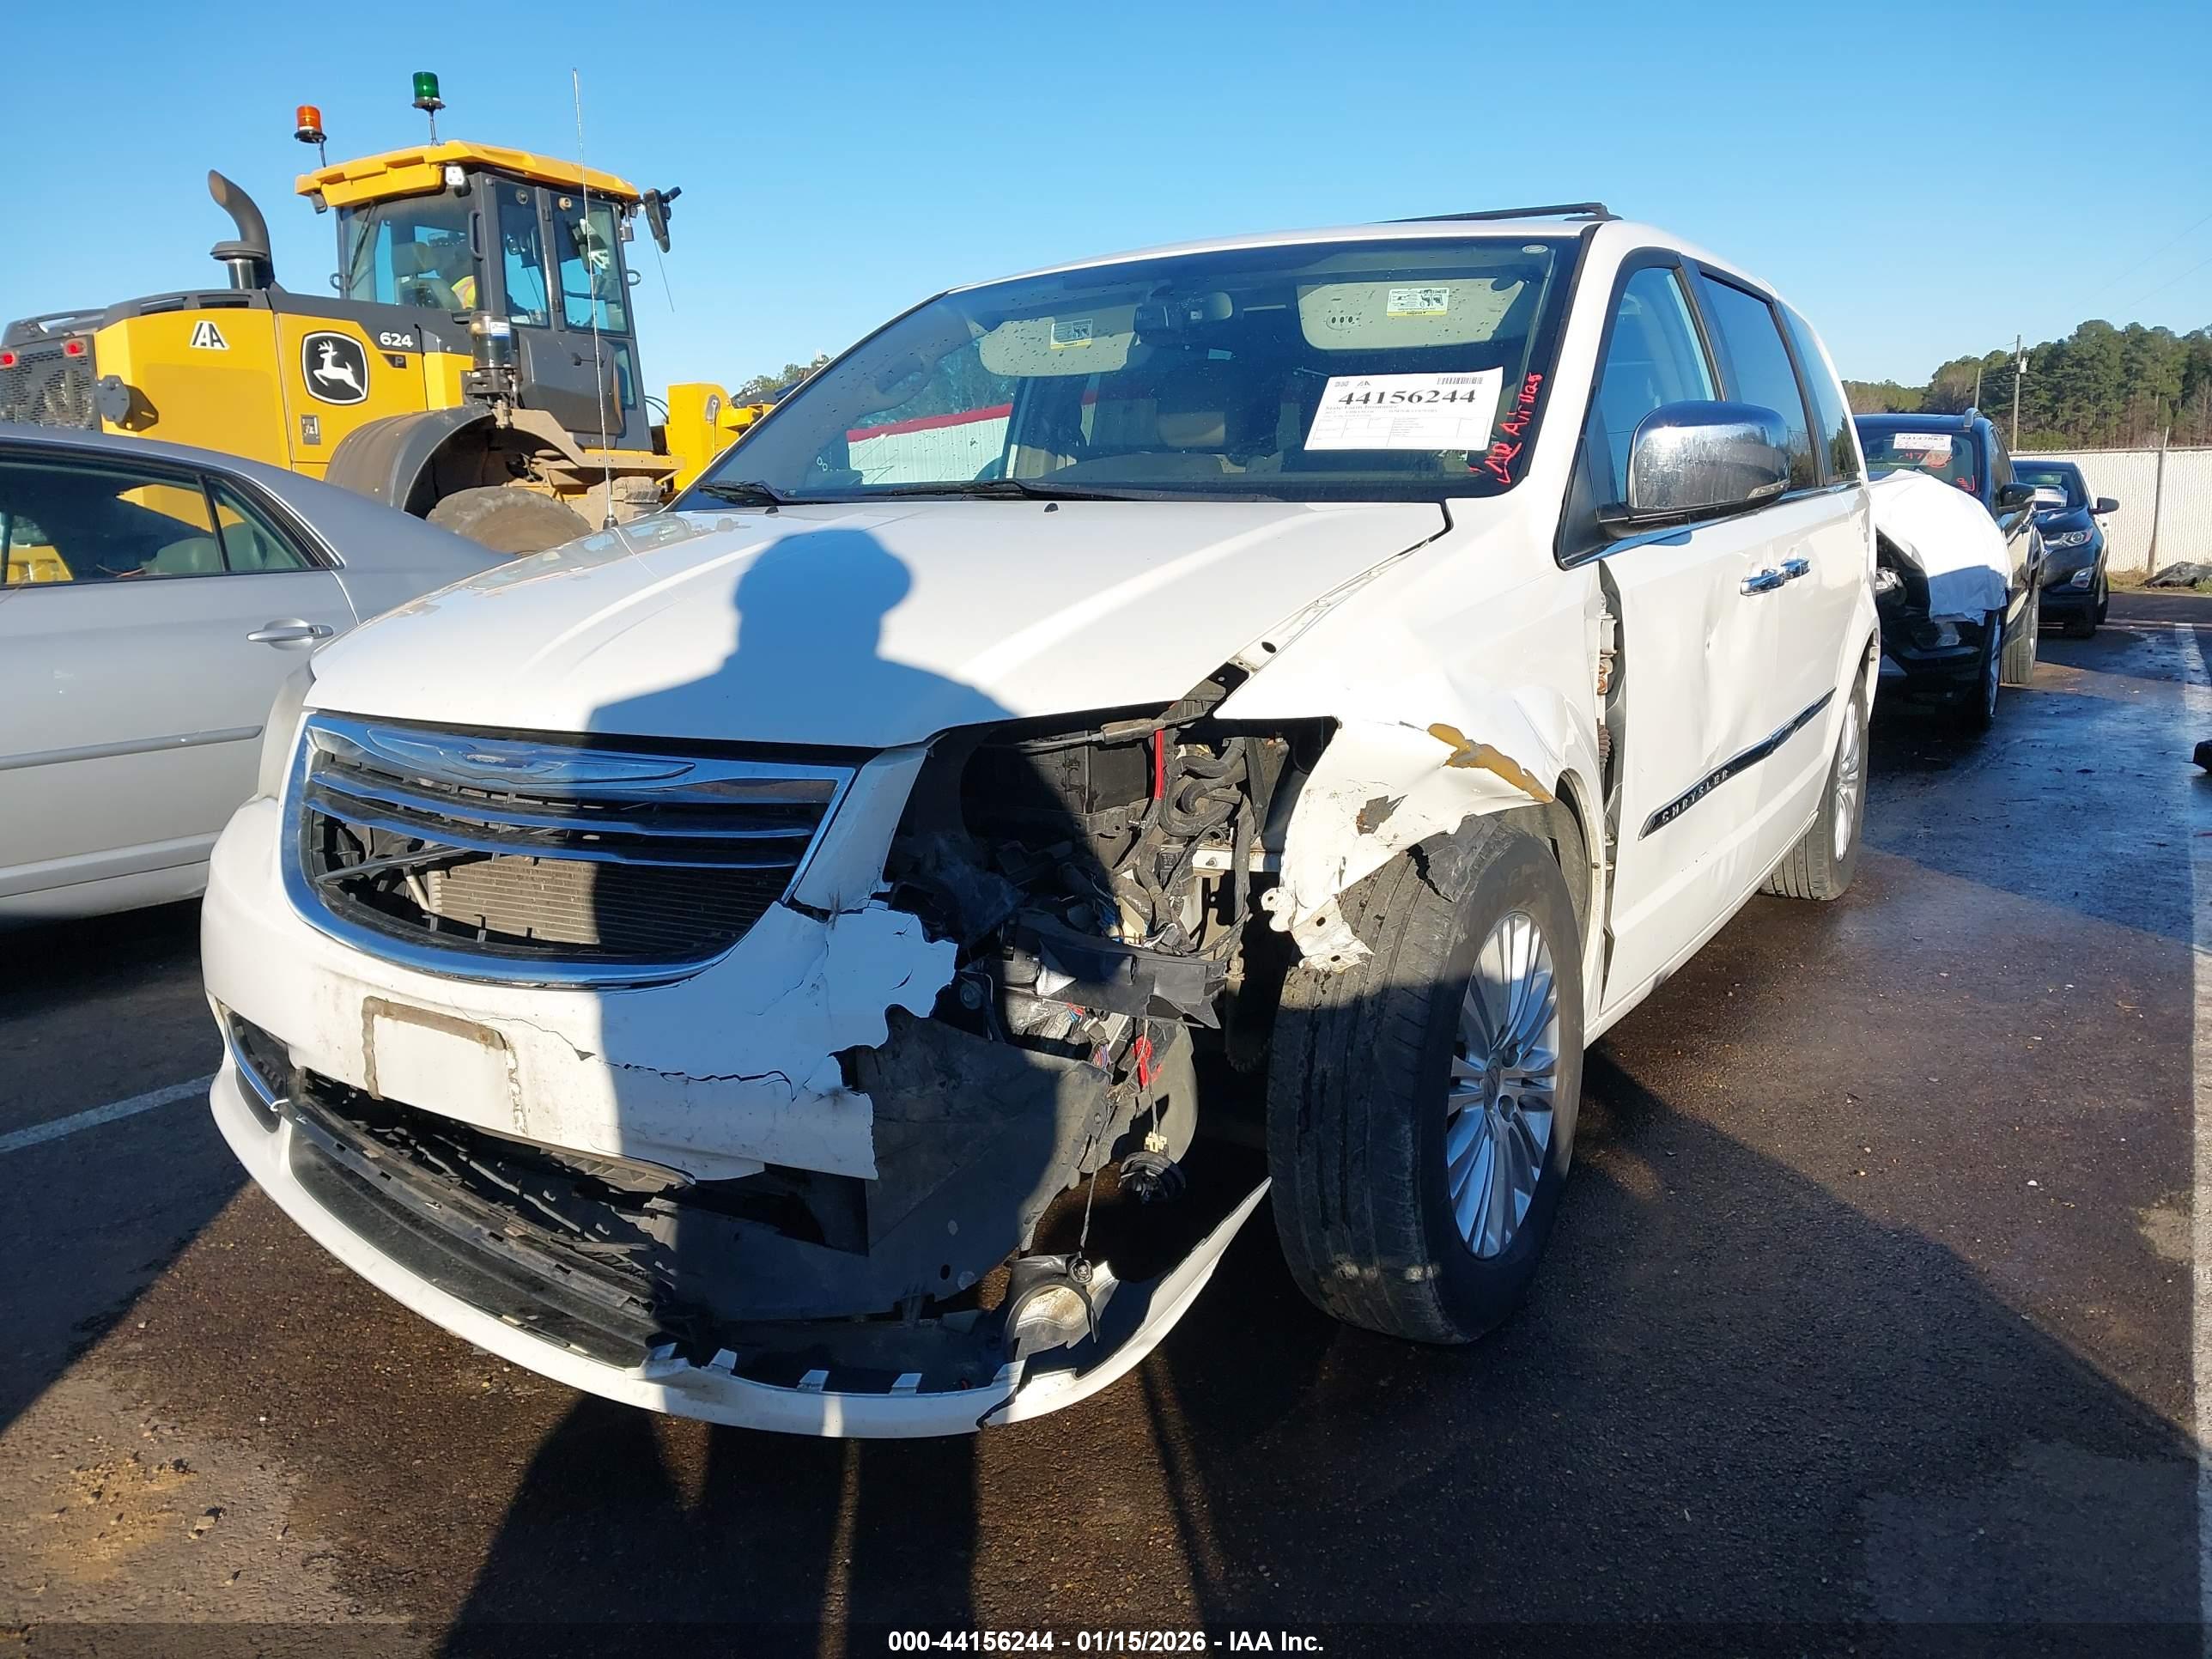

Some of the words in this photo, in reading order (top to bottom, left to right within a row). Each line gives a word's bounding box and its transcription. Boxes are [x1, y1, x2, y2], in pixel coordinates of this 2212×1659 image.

[380, 331, 414, 348] 624
[394, 356, 404, 367] P
[1338, 389, 1476, 405] 44156244
[1662, 769, 1729, 823] CHRYSLER
